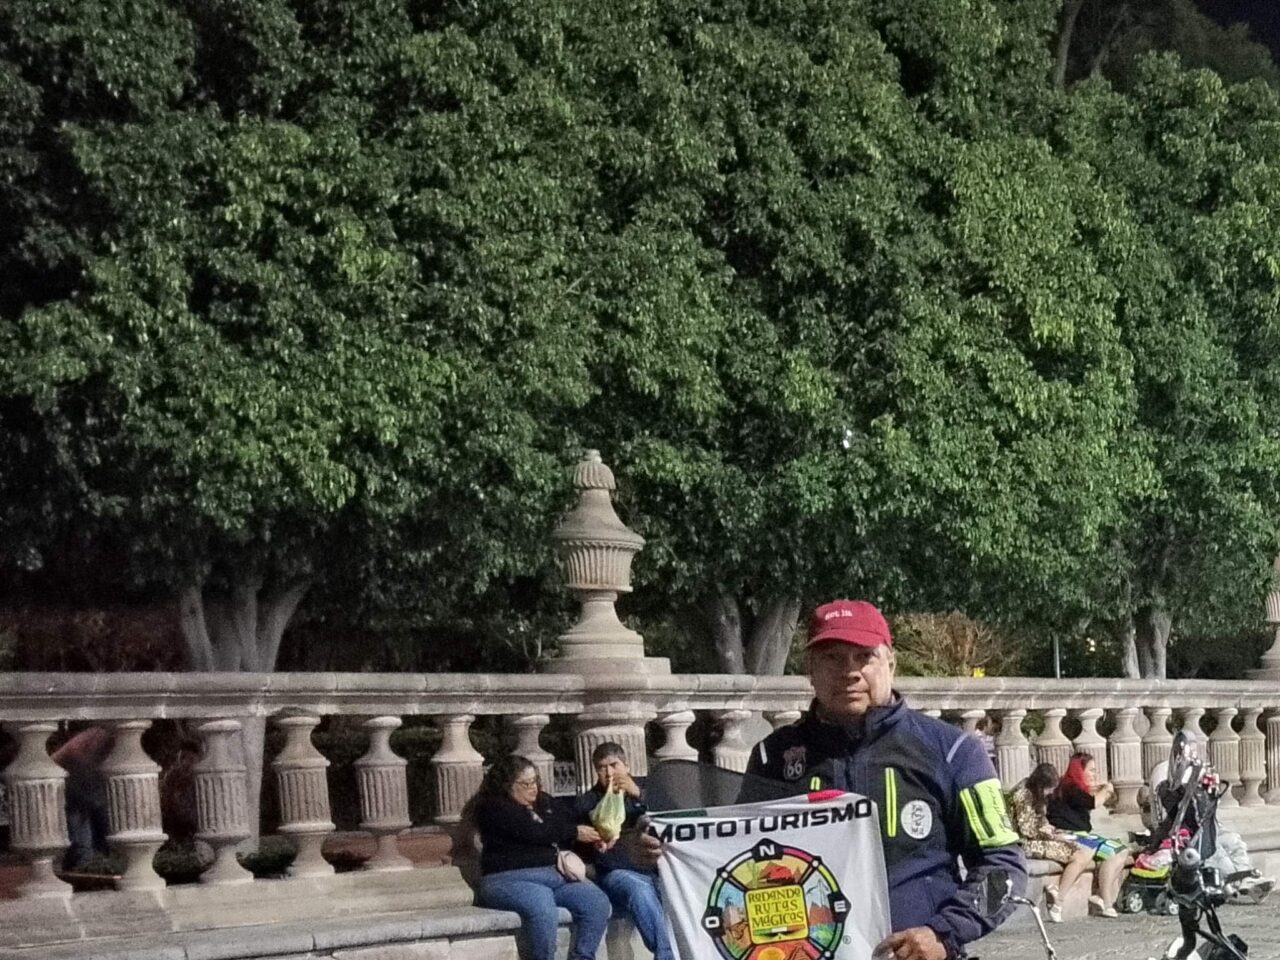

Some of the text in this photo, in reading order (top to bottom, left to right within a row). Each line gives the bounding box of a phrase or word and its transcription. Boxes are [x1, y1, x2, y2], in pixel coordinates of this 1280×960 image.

[651, 798, 872, 843] MOTOTURISMO
[759, 844, 776, 857] N
[834, 900, 847, 912] E
